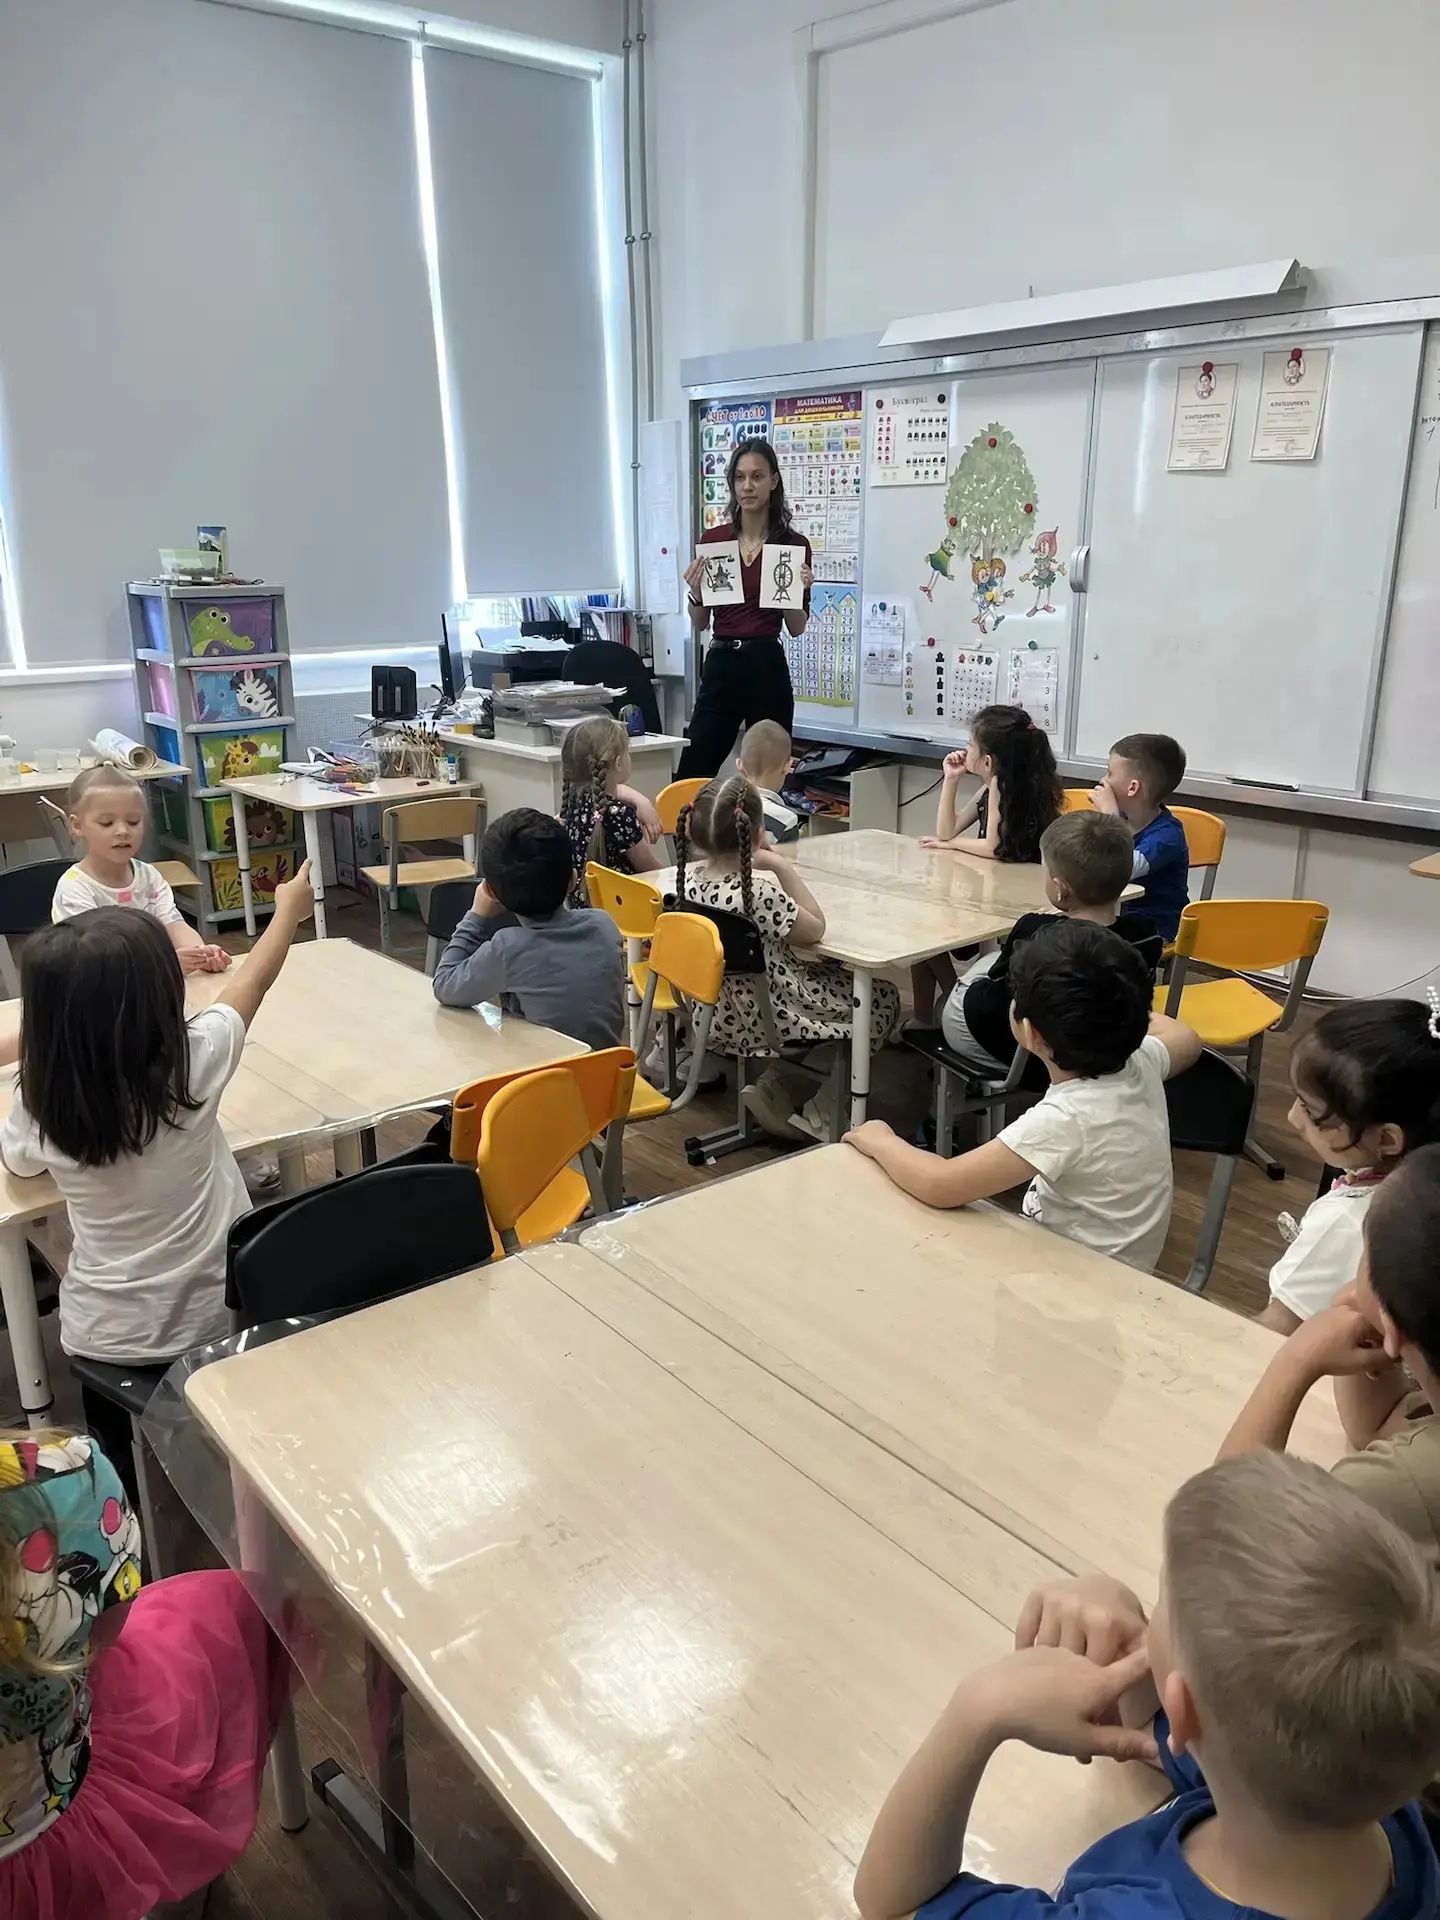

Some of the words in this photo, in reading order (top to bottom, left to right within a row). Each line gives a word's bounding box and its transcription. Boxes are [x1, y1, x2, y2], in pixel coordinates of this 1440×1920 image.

[796, 396, 842, 406] МАТЕМАТИКА
[754, 406, 766, 419] 10
[705, 428, 713, 448] 1
[737, 425, 746, 444] 6
[705, 454, 715, 474] 2
[706, 480, 715, 500] 3
